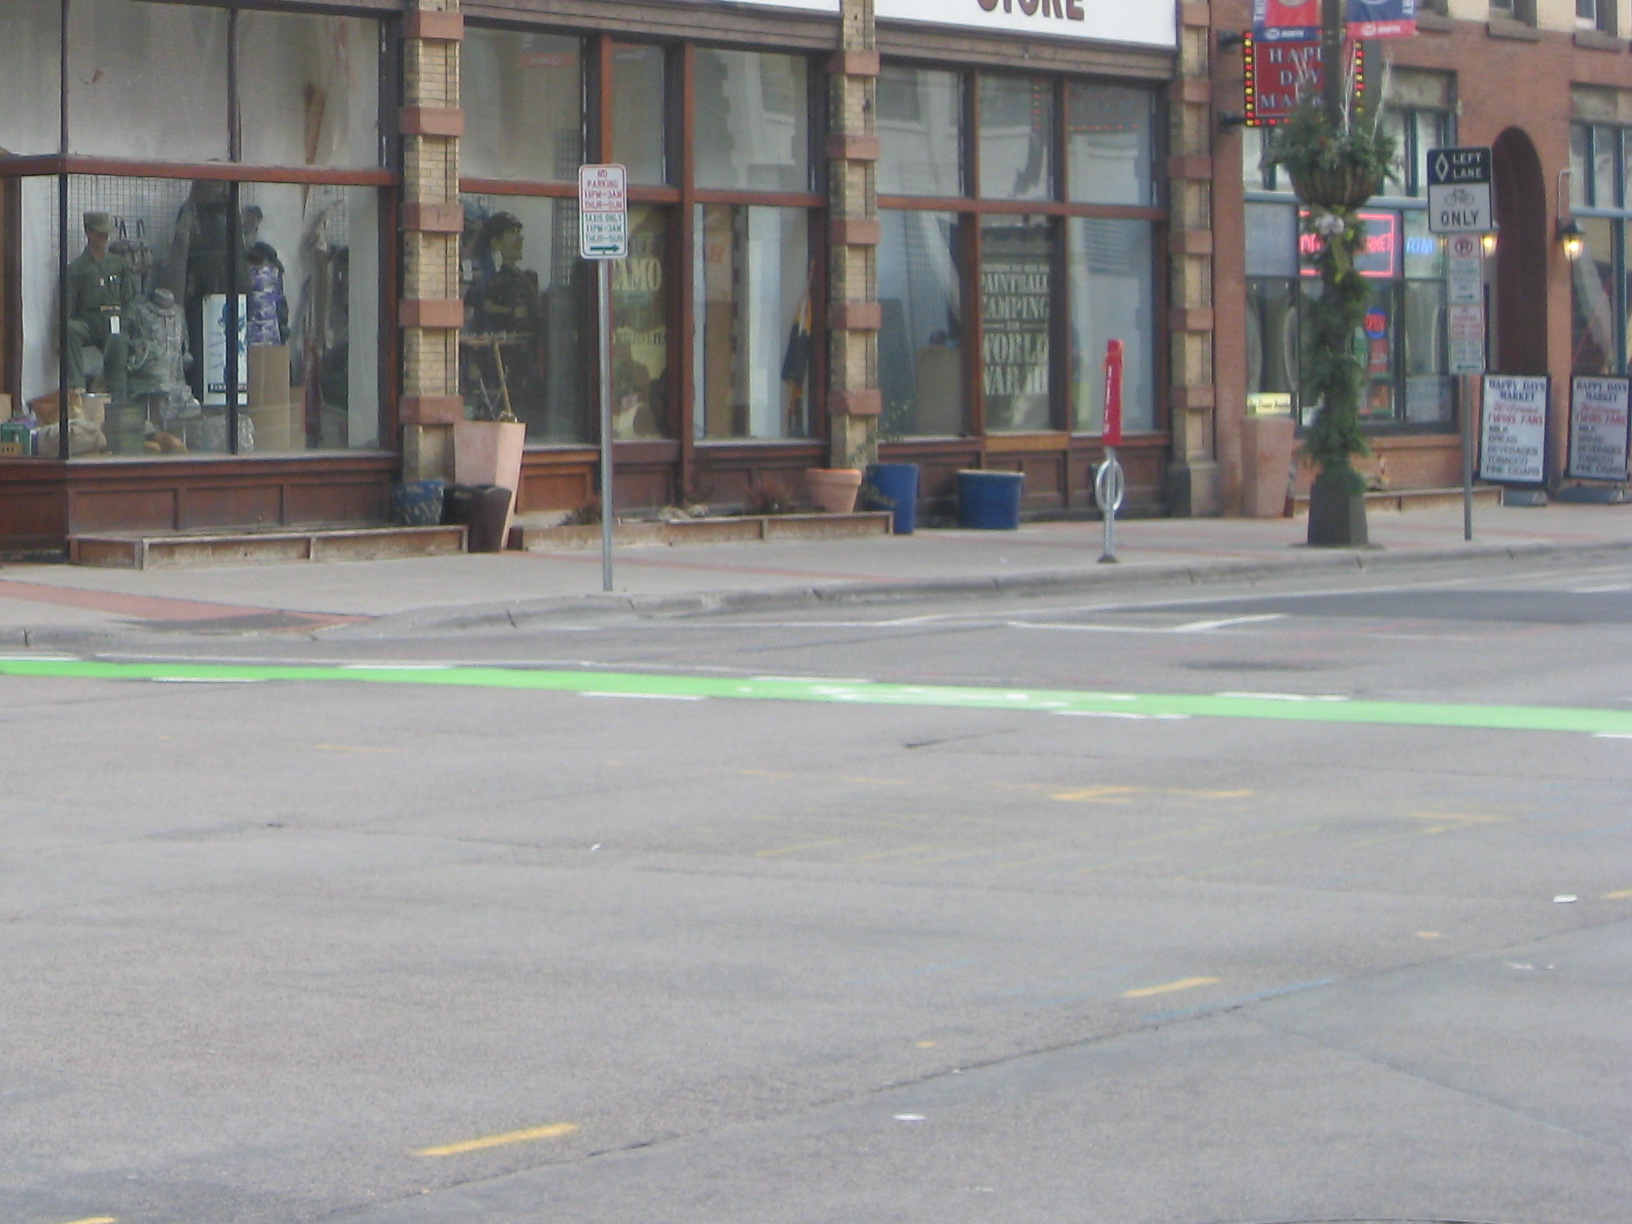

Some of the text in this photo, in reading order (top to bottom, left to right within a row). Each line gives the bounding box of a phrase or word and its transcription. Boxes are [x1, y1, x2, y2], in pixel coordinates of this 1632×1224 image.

[1270, 47, 1323, 63] HAP
[1280, 70, 1320, 86] DAY
[1453, 151, 1482, 164] LEFT
[597, 169, 608, 178] NO
[1453, 167, 1483, 179] LANE
[1440, 210, 1480, 226] ONLY
[1489, 379, 1546, 391] HAPPY DAYS
[1576, 380, 1628, 391] HAPPY DAYS
[1499, 391, 1535, 401] MARKET
[1585, 391, 1617, 402] MARKET
[1488, 413, 1544, 424] TWINS FANS
